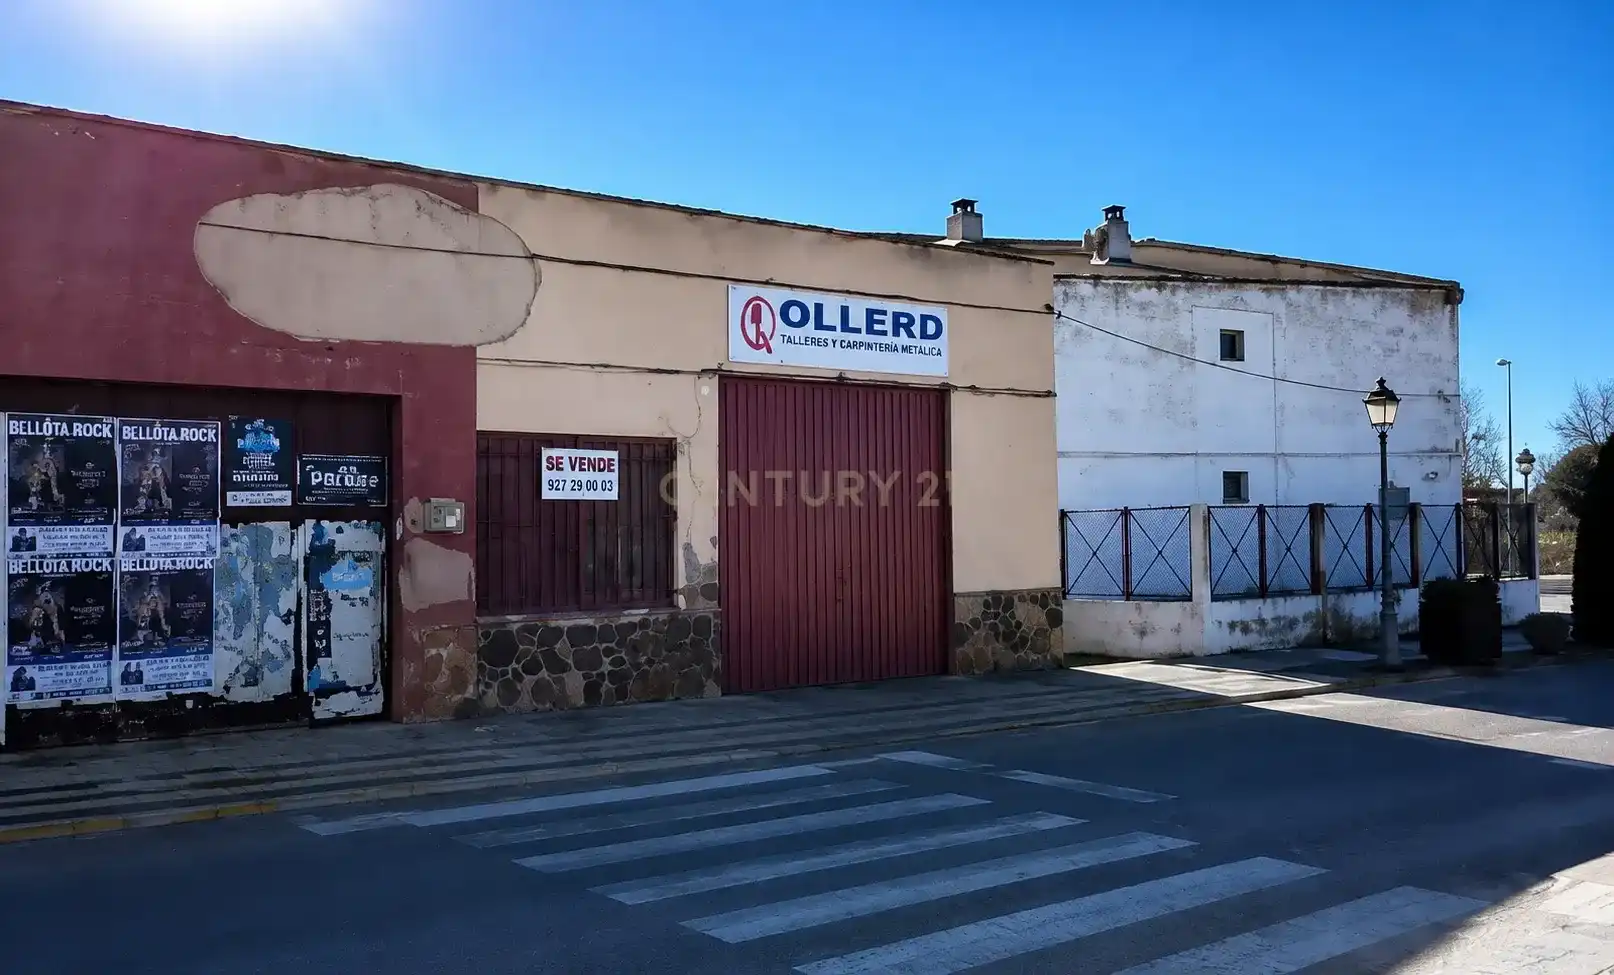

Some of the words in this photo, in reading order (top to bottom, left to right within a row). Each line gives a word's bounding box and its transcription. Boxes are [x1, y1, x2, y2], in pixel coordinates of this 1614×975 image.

[780, 334, 829, 348] TALLERES
[831, 339, 837, 348] Y
[839, 339, 899, 353] CARPINTERÍA
[73, 422, 112, 438] ROCK
[180, 427, 217, 442] ROCK
[545, 455, 564, 472] SE
[568, 456, 615, 473] VENDE
[547, 478, 567, 492] 927
[570, 479, 583, 492] 29
[585, 479, 598, 492] 00
[601, 479, 613, 492] 03
[71, 558, 112, 573] ROCK
[176, 557, 214, 570] ROCK
